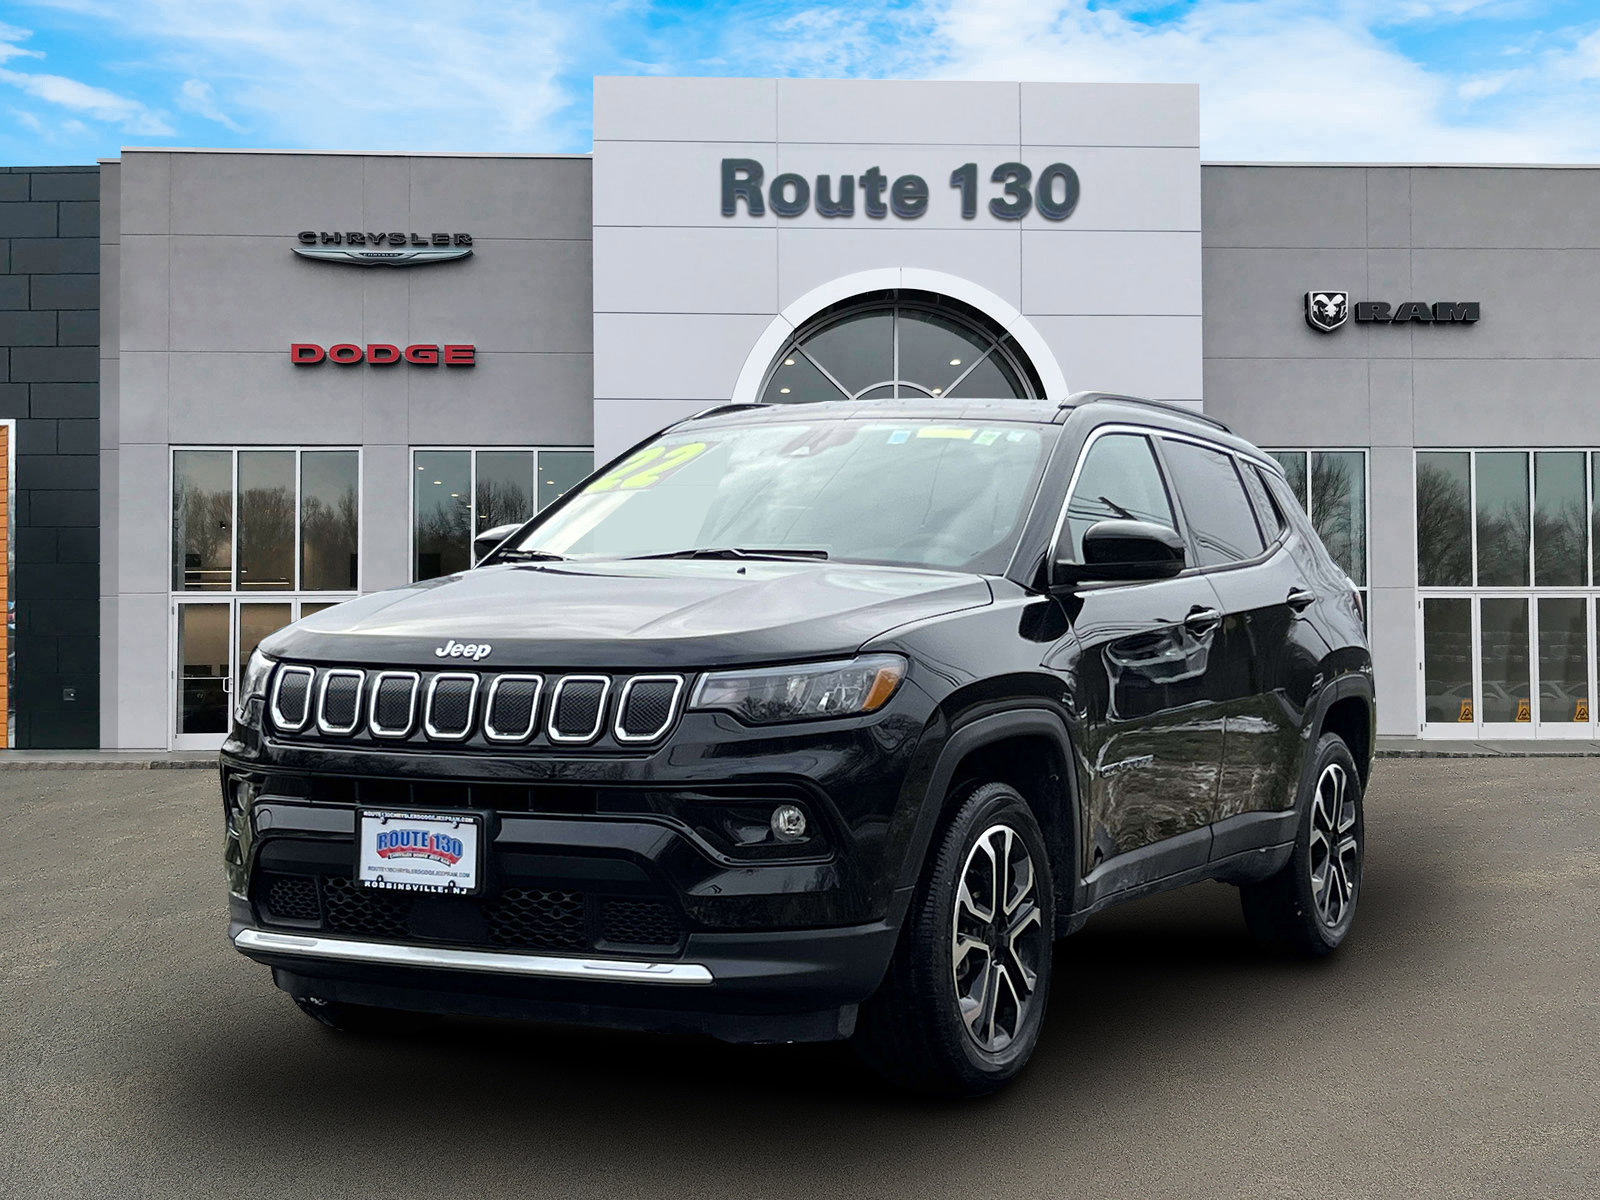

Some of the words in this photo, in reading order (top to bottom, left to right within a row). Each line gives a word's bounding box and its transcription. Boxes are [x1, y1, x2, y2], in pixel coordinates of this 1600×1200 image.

[721, 158, 929, 218] Route
[950, 162, 1080, 220] 130
[298, 231, 472, 246] CHRYSLER
[1355, 301, 1480, 324] RAM
[291, 343, 476, 365] DODGE
[583, 442, 706, 492] 22
[435, 640, 492, 661] Jeep
[377, 829, 430, 851] ROUTE
[431, 834, 463, 858] 130
[364, 880, 448, 894] ROBBINSVILLE,
